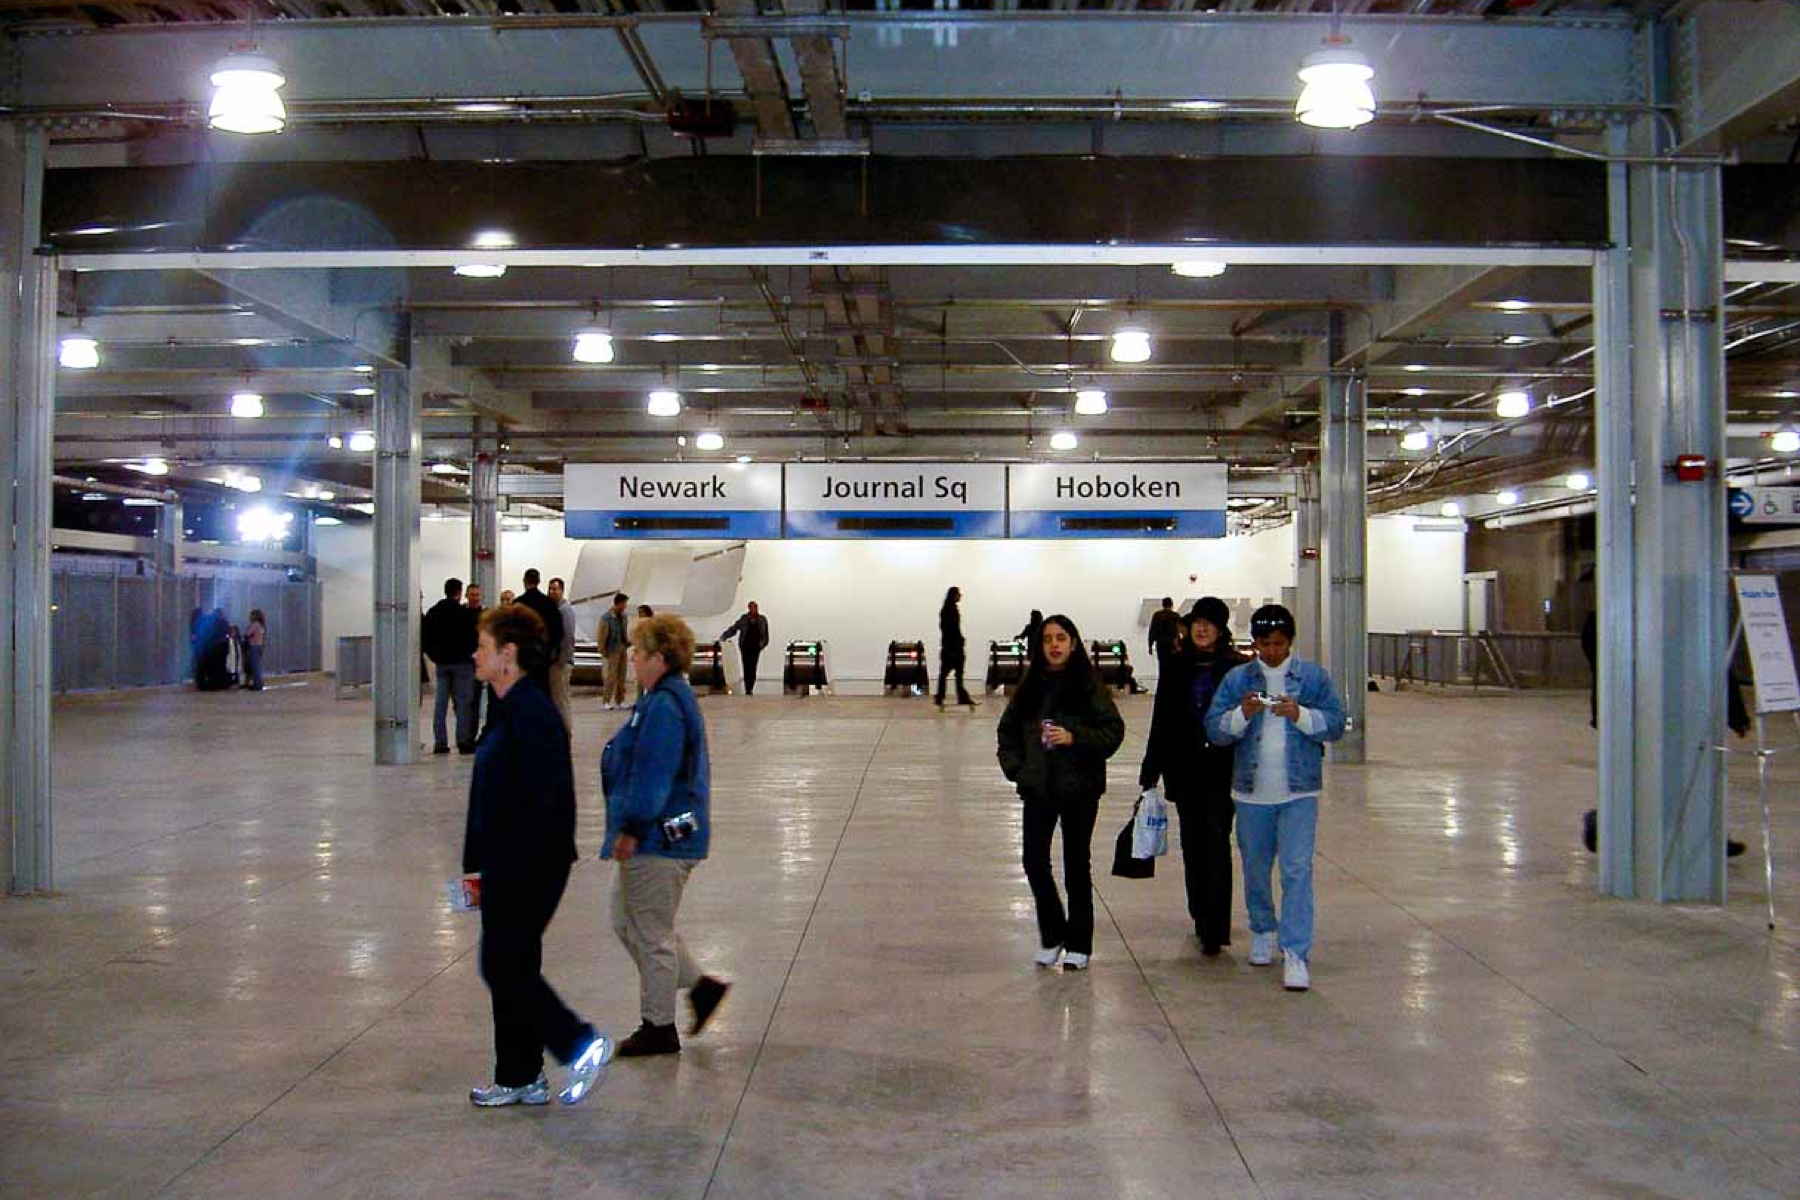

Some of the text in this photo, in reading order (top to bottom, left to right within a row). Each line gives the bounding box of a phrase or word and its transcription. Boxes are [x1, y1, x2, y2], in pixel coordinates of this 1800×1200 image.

[620, 475, 726, 498] Newark
[822, 475, 967, 504] Journal Sq
[1056, 475, 1181, 498] Hoboken
